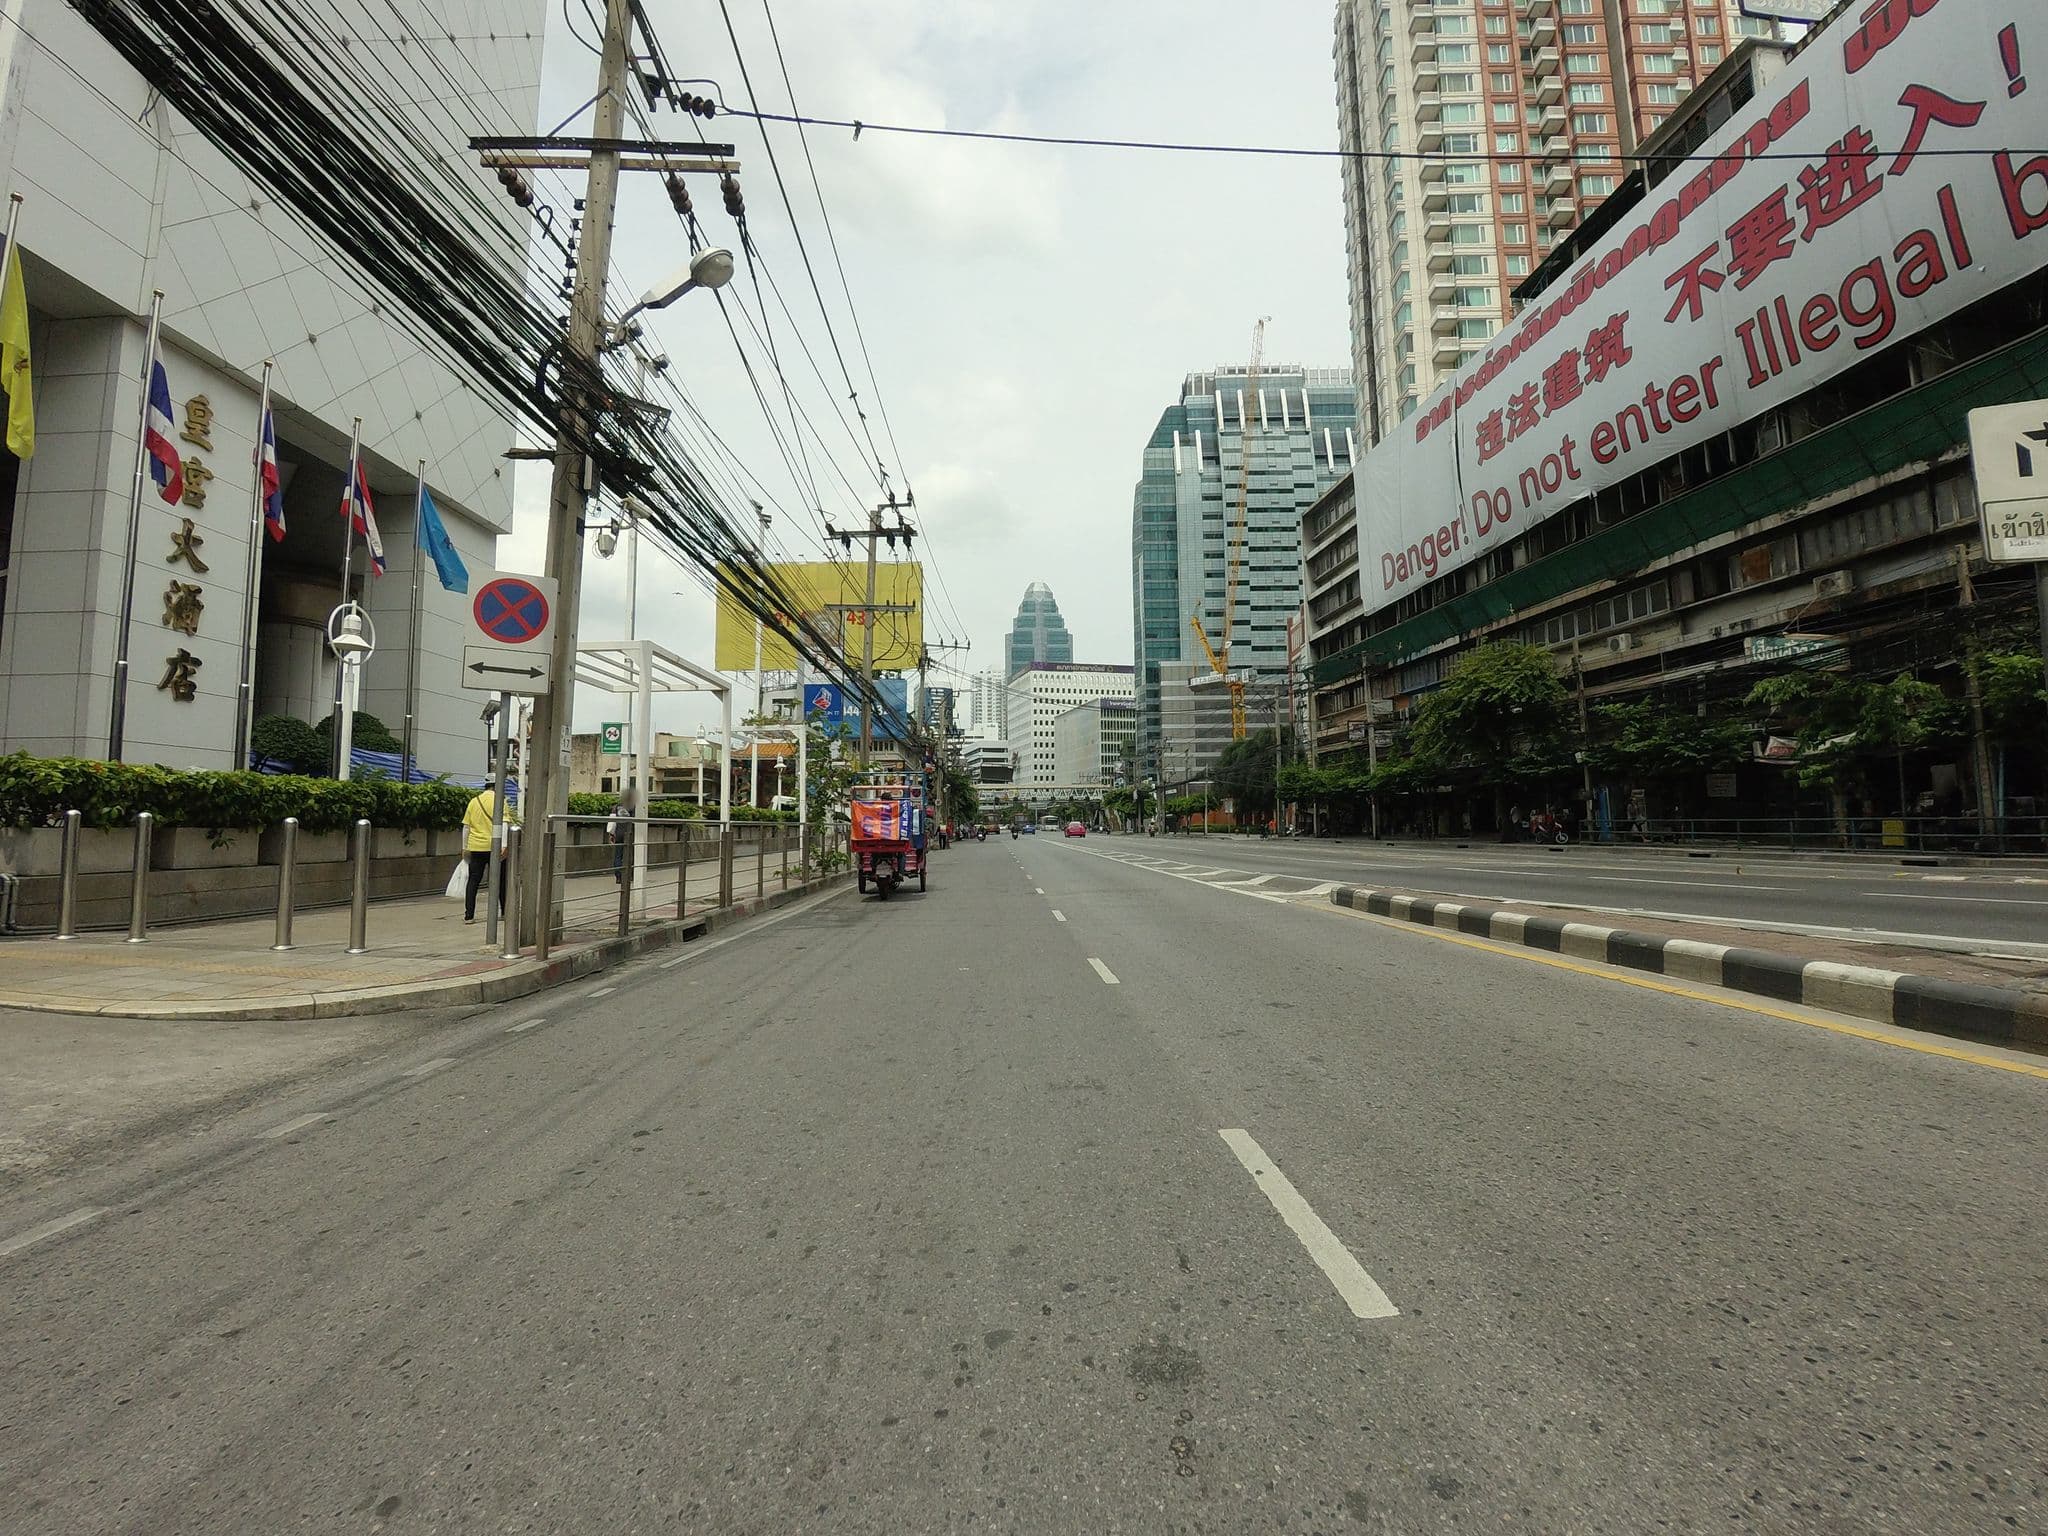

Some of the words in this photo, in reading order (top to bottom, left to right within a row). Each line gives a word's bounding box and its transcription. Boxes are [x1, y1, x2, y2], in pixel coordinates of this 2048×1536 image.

[1381, 503, 1470, 591] Danger!
[1471, 486, 1512, 538] Do
[1518, 432, 1582, 508] not
[1590, 355, 1723, 464] enter
[1734, 183, 1973, 389] Illegal
[1991, 511, 2048, 539] เข้าชิ
